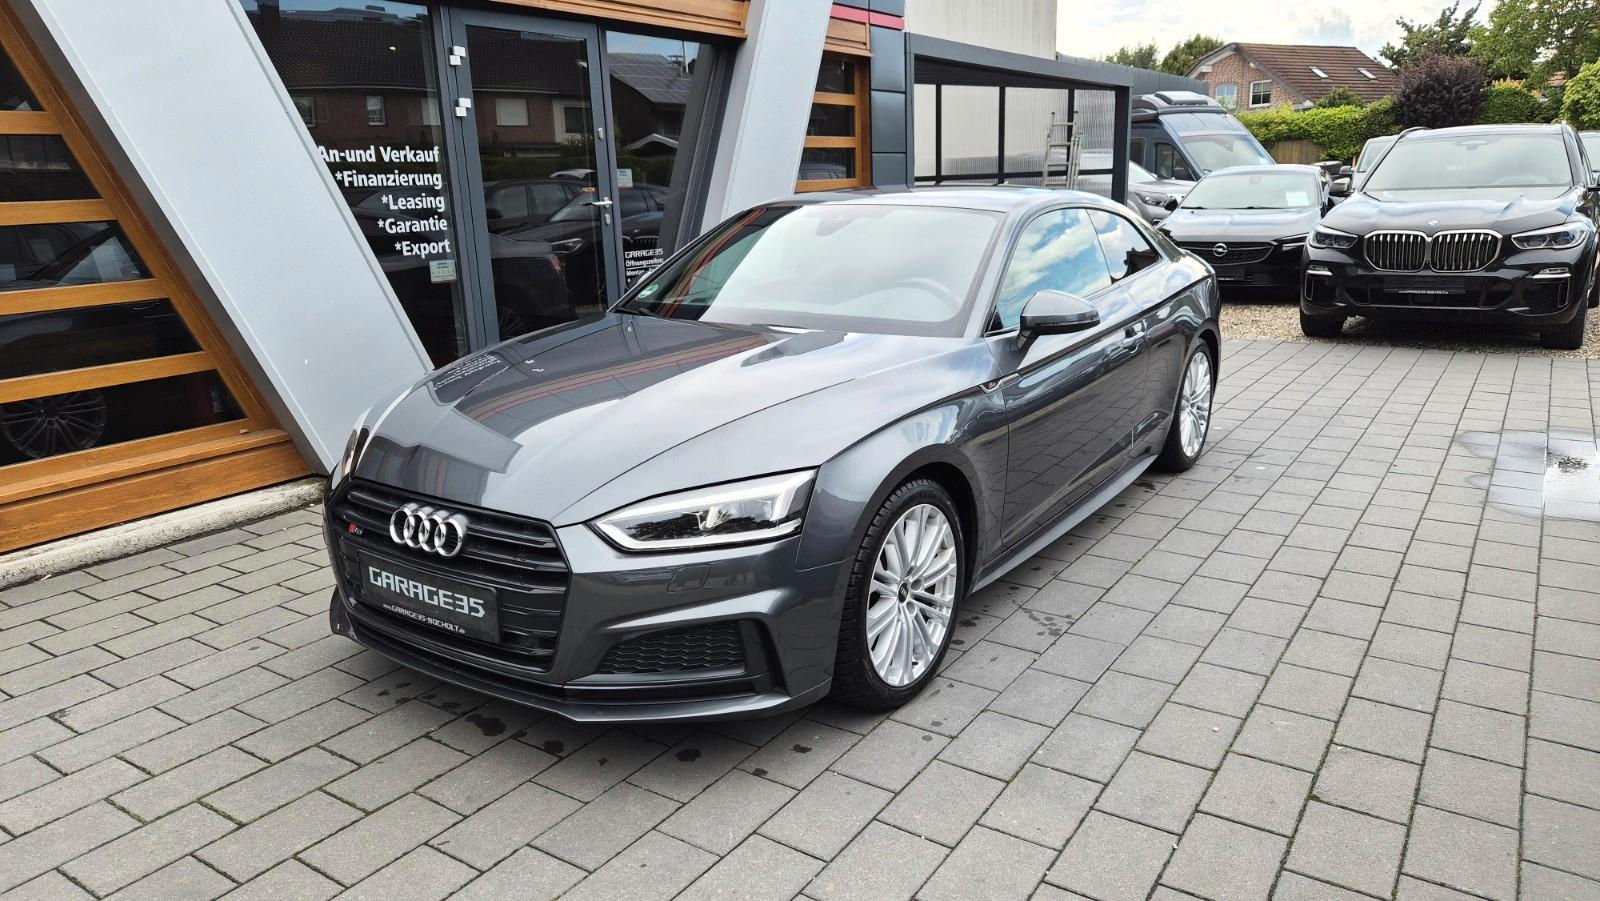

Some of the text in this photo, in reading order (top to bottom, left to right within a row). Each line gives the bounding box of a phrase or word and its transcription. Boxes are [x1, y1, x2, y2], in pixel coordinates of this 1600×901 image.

[317, 145, 440, 163] An-und Verkauf
[625, 248, 663, 258] GARAGE35
[368, 566, 486, 618] GARAGE35
